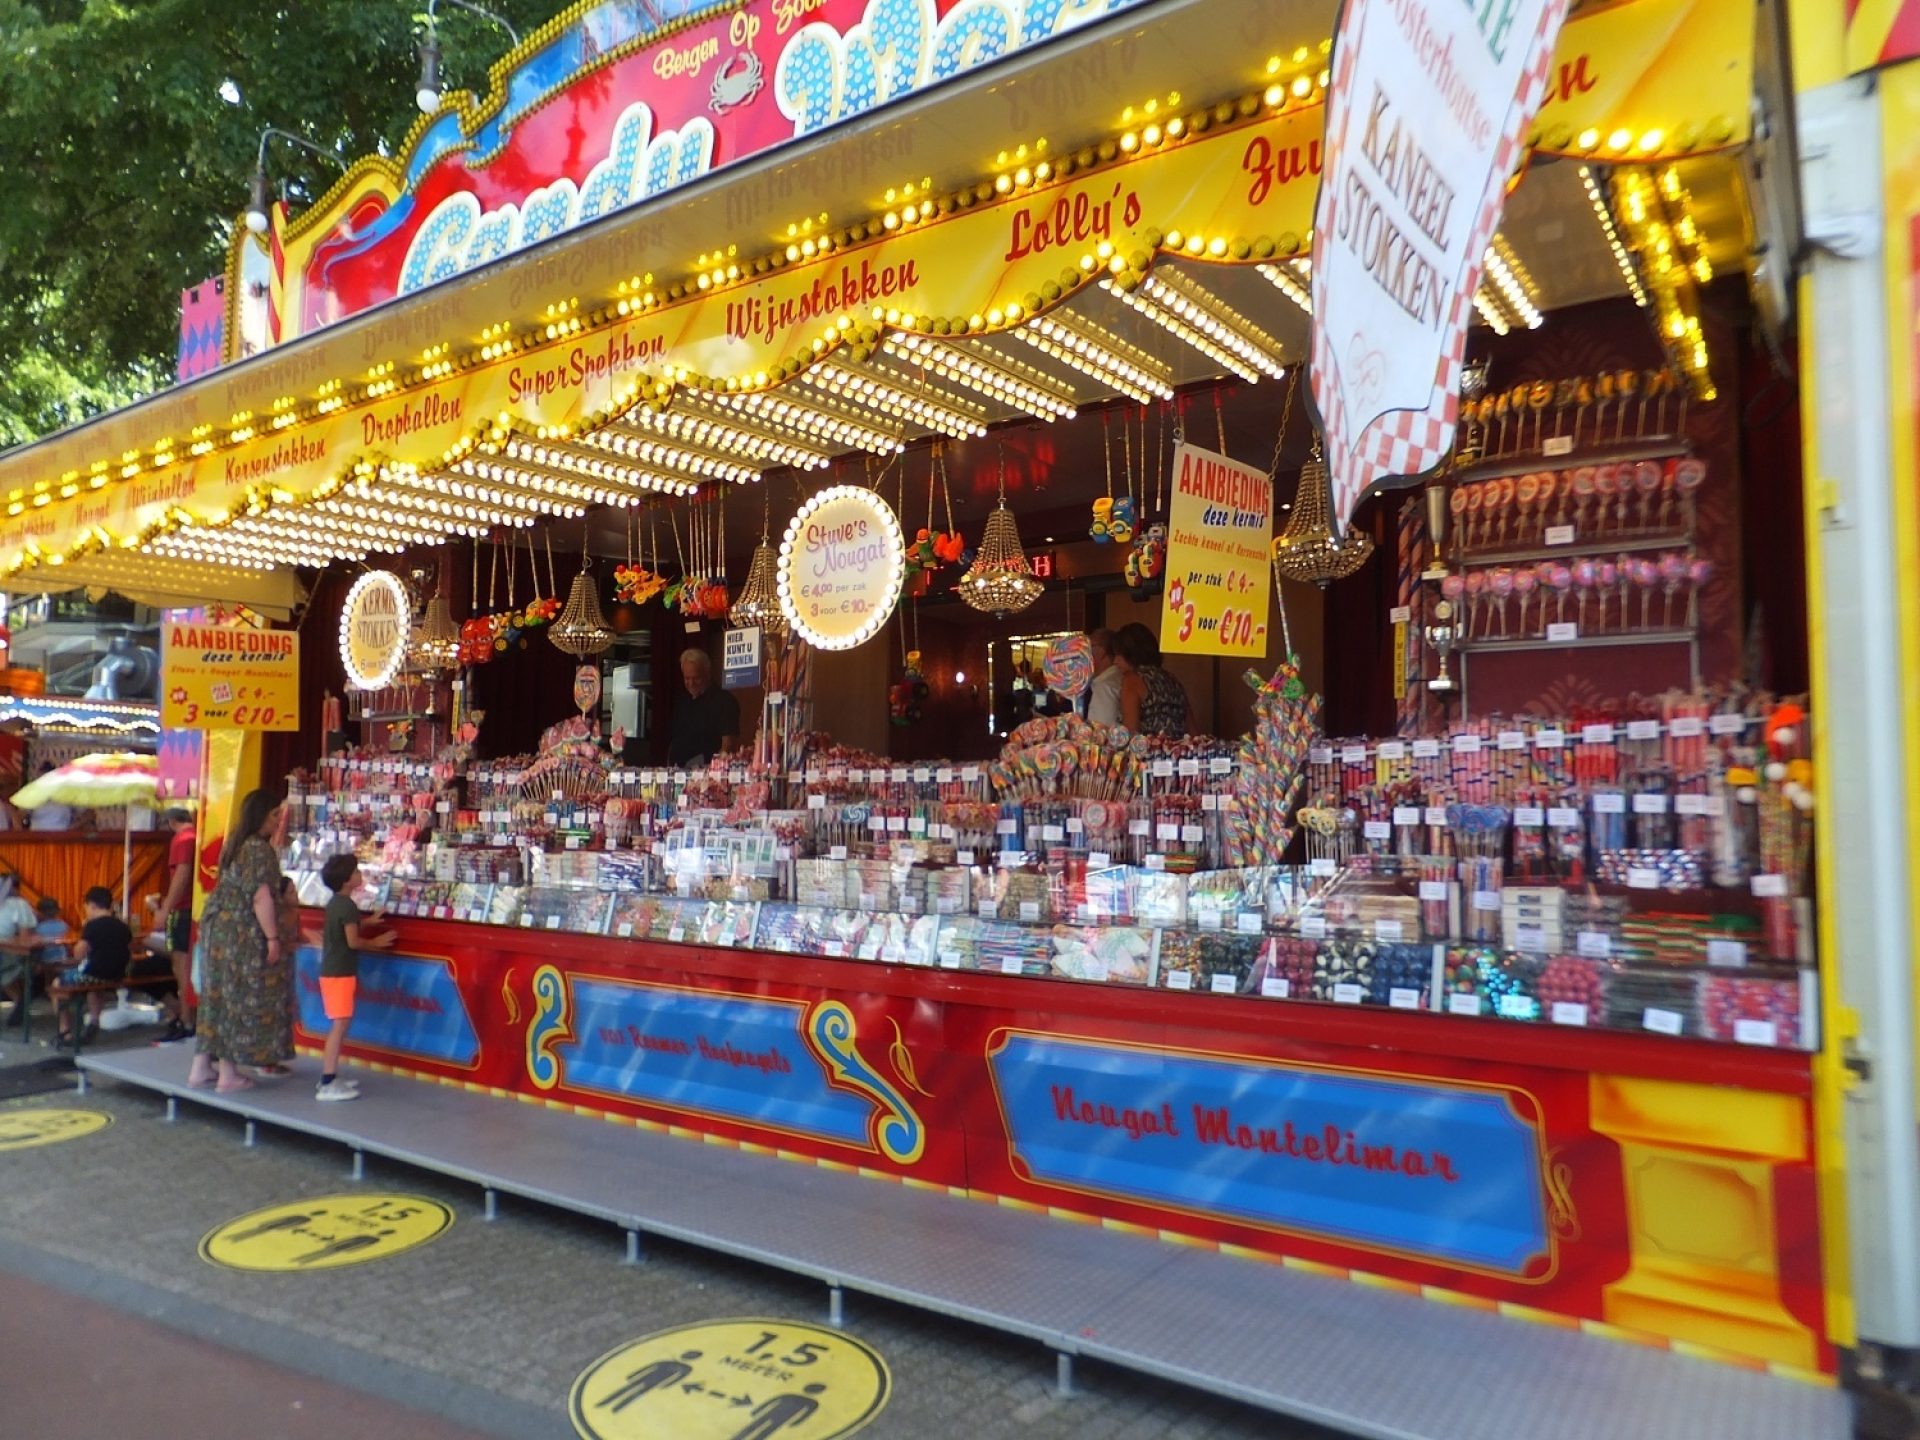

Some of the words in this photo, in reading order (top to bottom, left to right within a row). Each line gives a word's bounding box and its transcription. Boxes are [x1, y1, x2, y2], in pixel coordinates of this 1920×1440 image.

[653, 37, 719, 80] Bergen
[729, 10, 761, 50] Op
[1361, 77, 1456, 254] KANEEL
[1005, 182, 1142, 262] Lolly's
[1338, 164, 1450, 333] STOKKEN
[725, 257, 920, 345] Wijnstokken
[361, 392, 463, 447] Dropballen
[225, 434, 326, 486] Kersenstokken
[1178, 453, 1271, 518] AANBIEDING
[806, 519, 868, 553] Stuve's
[1202, 504, 1229, 528] deze
[1232, 506, 1266, 530] kermis
[813, 535, 887, 578] Nougat
[835, 584, 849, 595] per
[1187, 570, 1202, 587] per
[1206, 571, 1223, 588] stuk
[810, 603, 819, 617] 3
[820, 607, 837, 616] voor
[1179, 602, 1195, 643] 3
[1197, 616, 1218, 631] voor
[171, 627, 293, 655] AANBIEDING
[201, 651, 233, 663] deze
[239, 650, 286, 663] kermis
[184, 704, 199, 724] 3
[1049, 1083, 1180, 1140] Nougat
[1191, 1102, 1461, 1185] Montelimar
[717, 1354, 795, 1384] METER
[743, 1331, 831, 1367] 1,5
